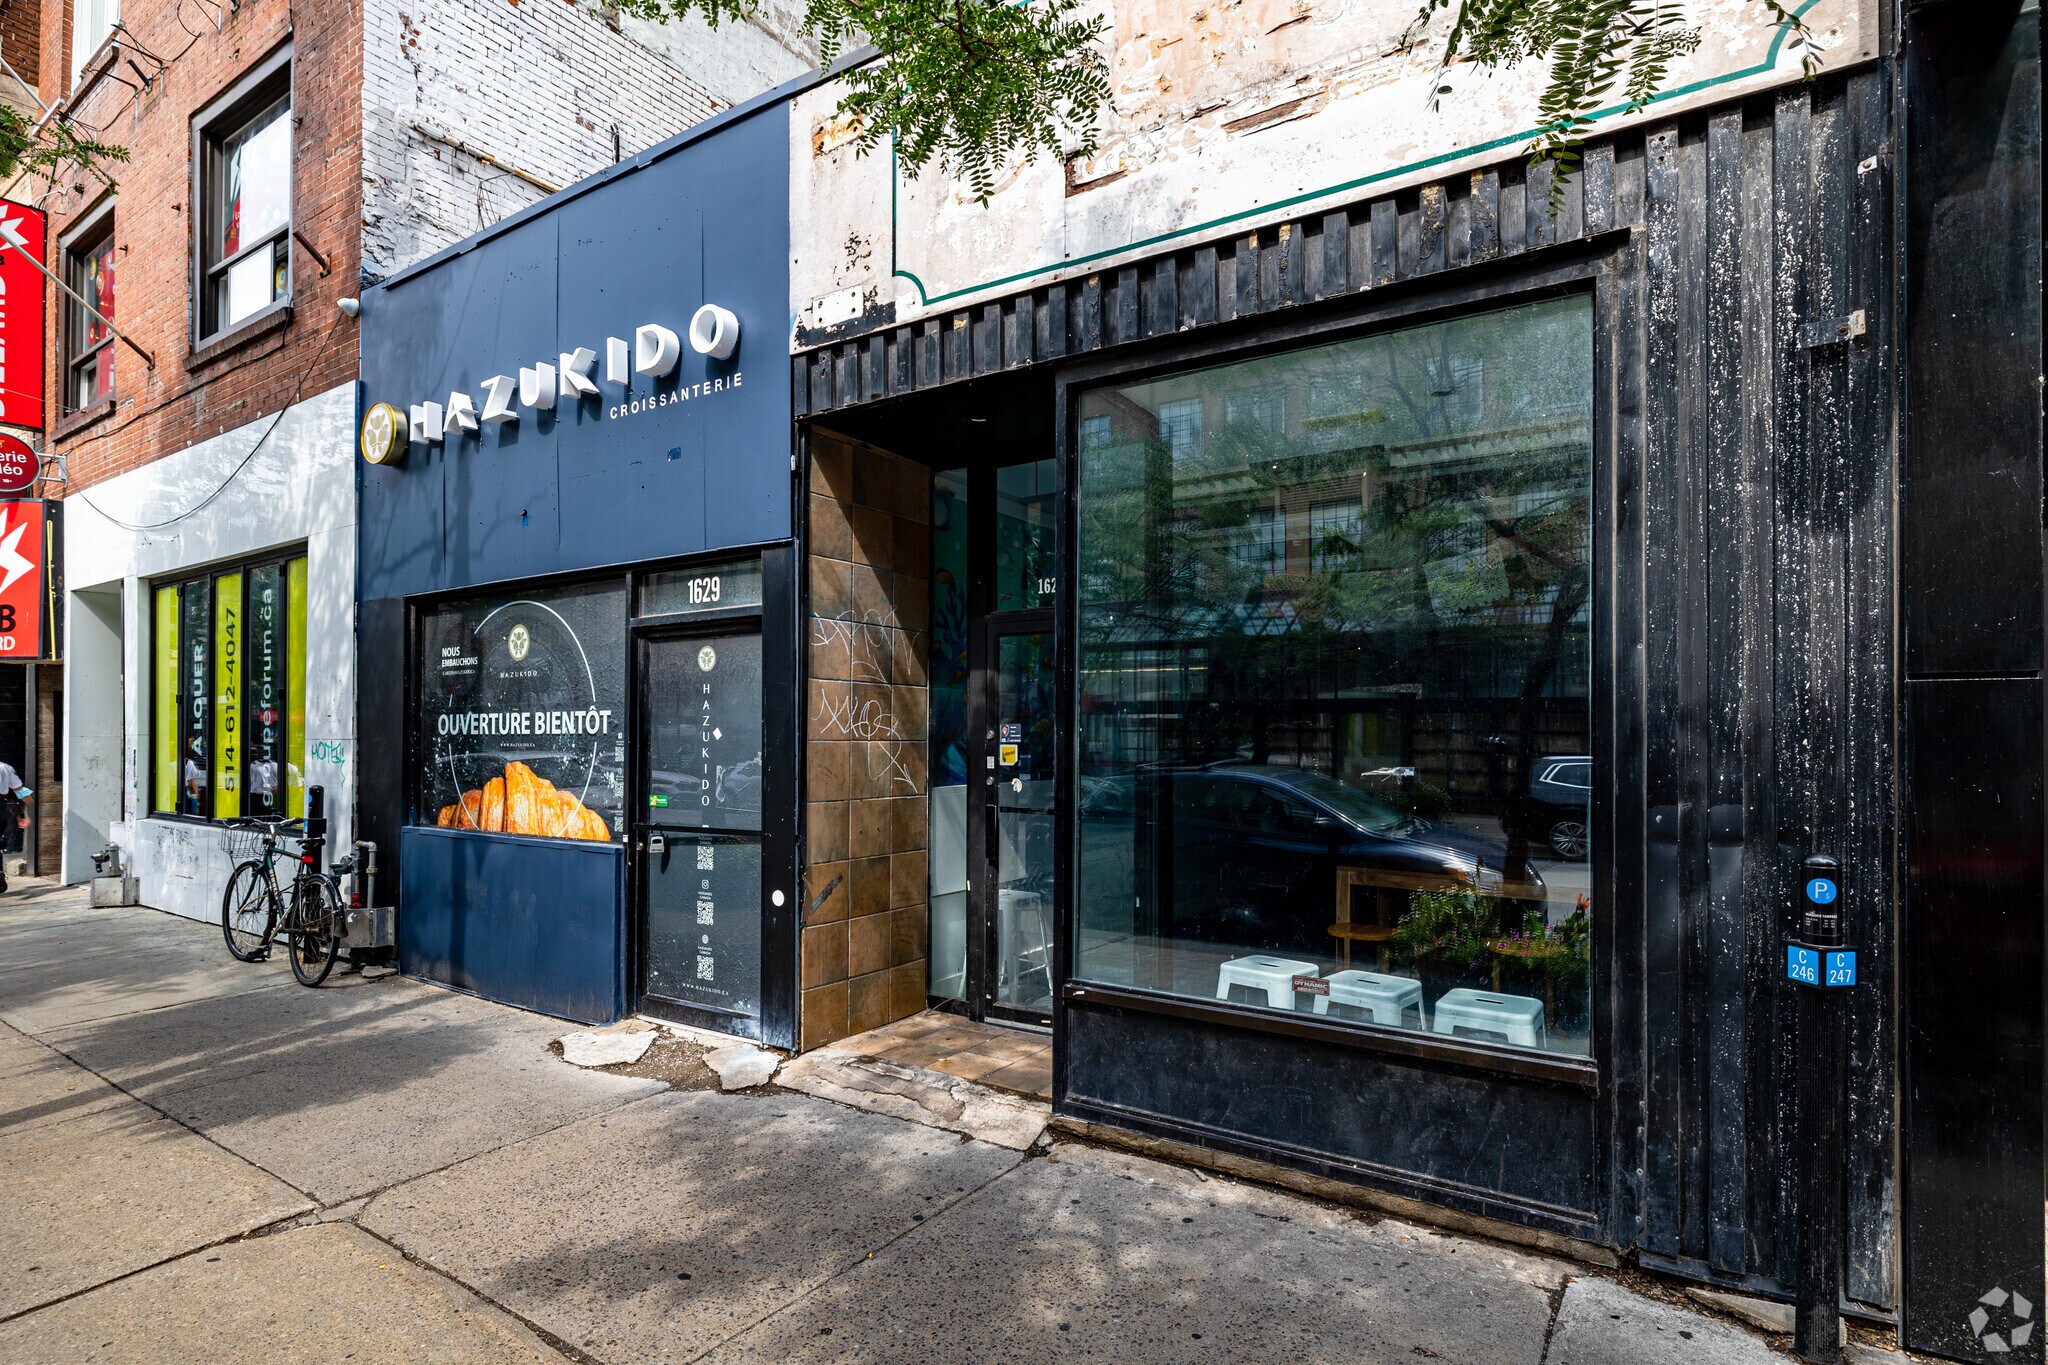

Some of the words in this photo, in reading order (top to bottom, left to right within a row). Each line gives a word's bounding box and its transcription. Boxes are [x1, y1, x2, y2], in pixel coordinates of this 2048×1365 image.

[410, 303, 739, 444] HAZUKIDO
[610, 372, 743, 419] CROISSANTERIE
[688, 576, 721, 604] 1629
[441, 646, 461, 658] NOUS
[441, 656, 478, 668] EMBAUCHONS
[500, 670, 538, 679] HAZUKIDO
[193, 643, 203, 730] LOUER
[225, 606, 237, 793] 514-612-4047
[262, 588, 274, 808] groupeforum.ca
[437, 711, 531, 736] OUVERTURE
[534, 705, 612, 735] BIENTÔT
[702, 683, 711, 807] HAZUKIDO
[1798, 950, 1807, 964] C
[1836, 953, 1845, 967] C
[1791, 964, 1815, 981] 246
[1829, 969, 1852, 984] 247
[1294, 980, 1328, 989] DYNAMIC
